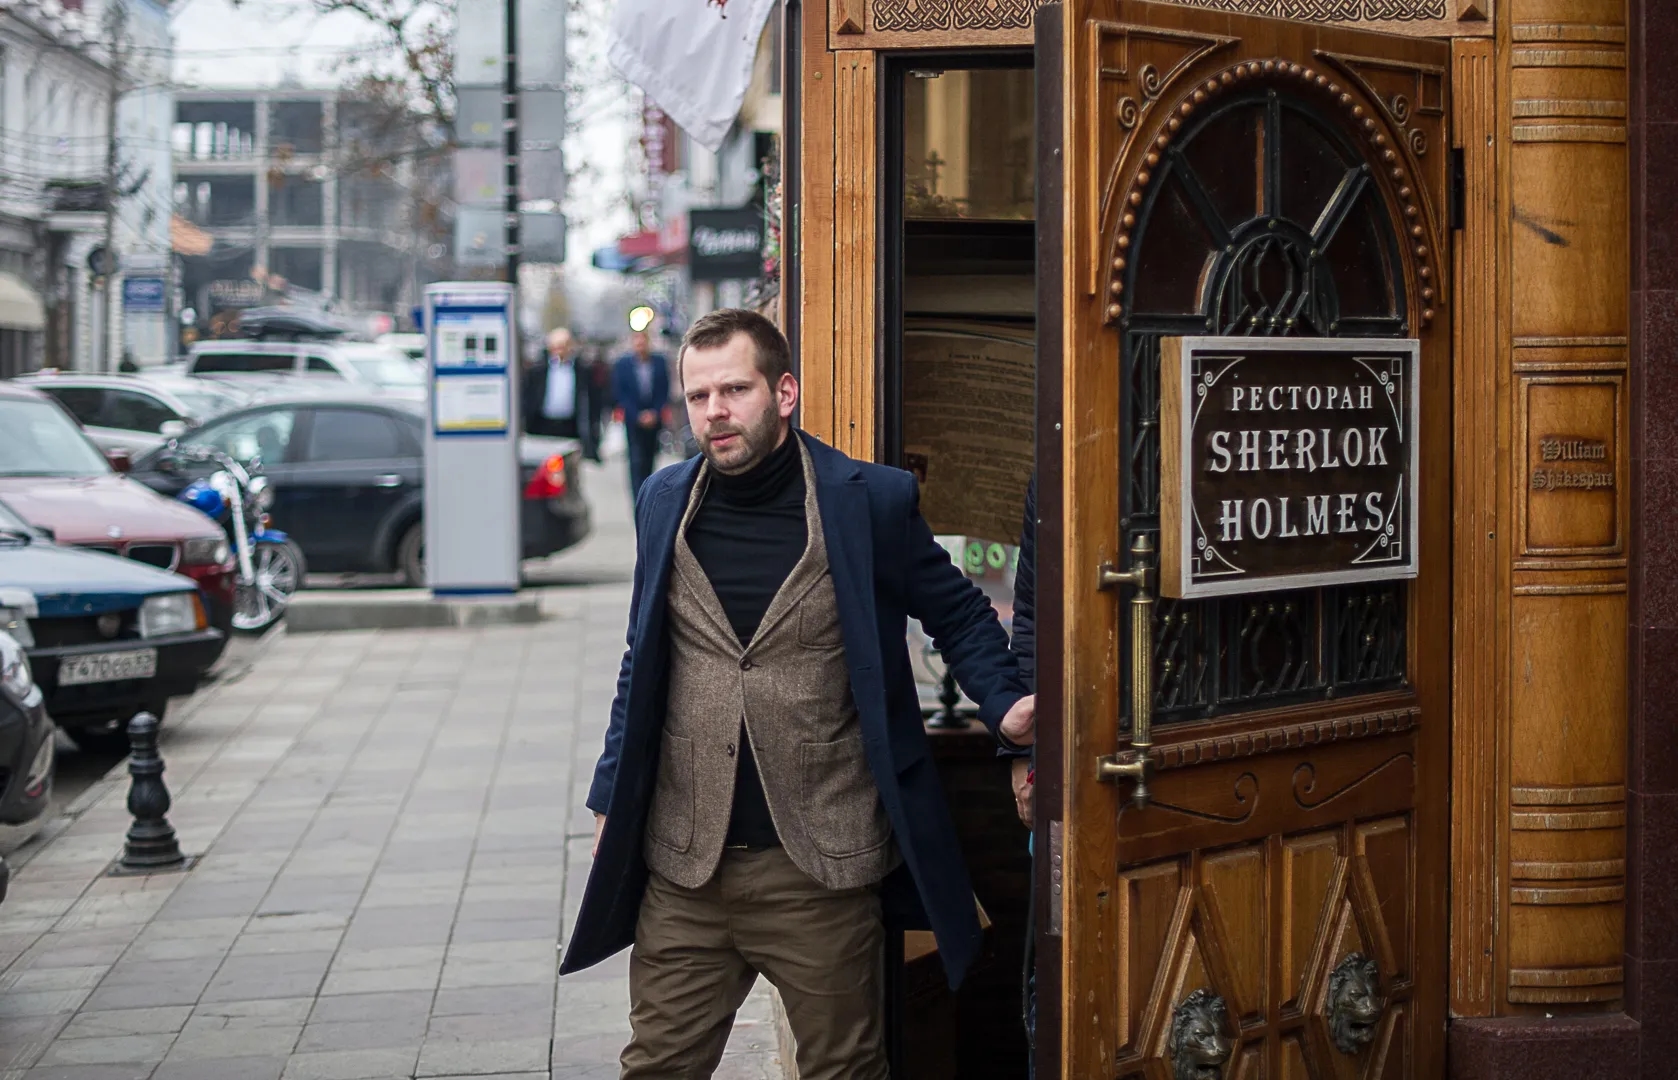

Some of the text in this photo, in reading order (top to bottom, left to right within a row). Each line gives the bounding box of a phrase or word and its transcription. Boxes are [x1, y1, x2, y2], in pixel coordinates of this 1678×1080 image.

[1231, 385, 1373, 411] РЕСТОРАН
[1210, 427, 1388, 473] SHERLOK
[1540, 439, 1606, 460] William
[1220, 491, 1384, 542] HOLMES
